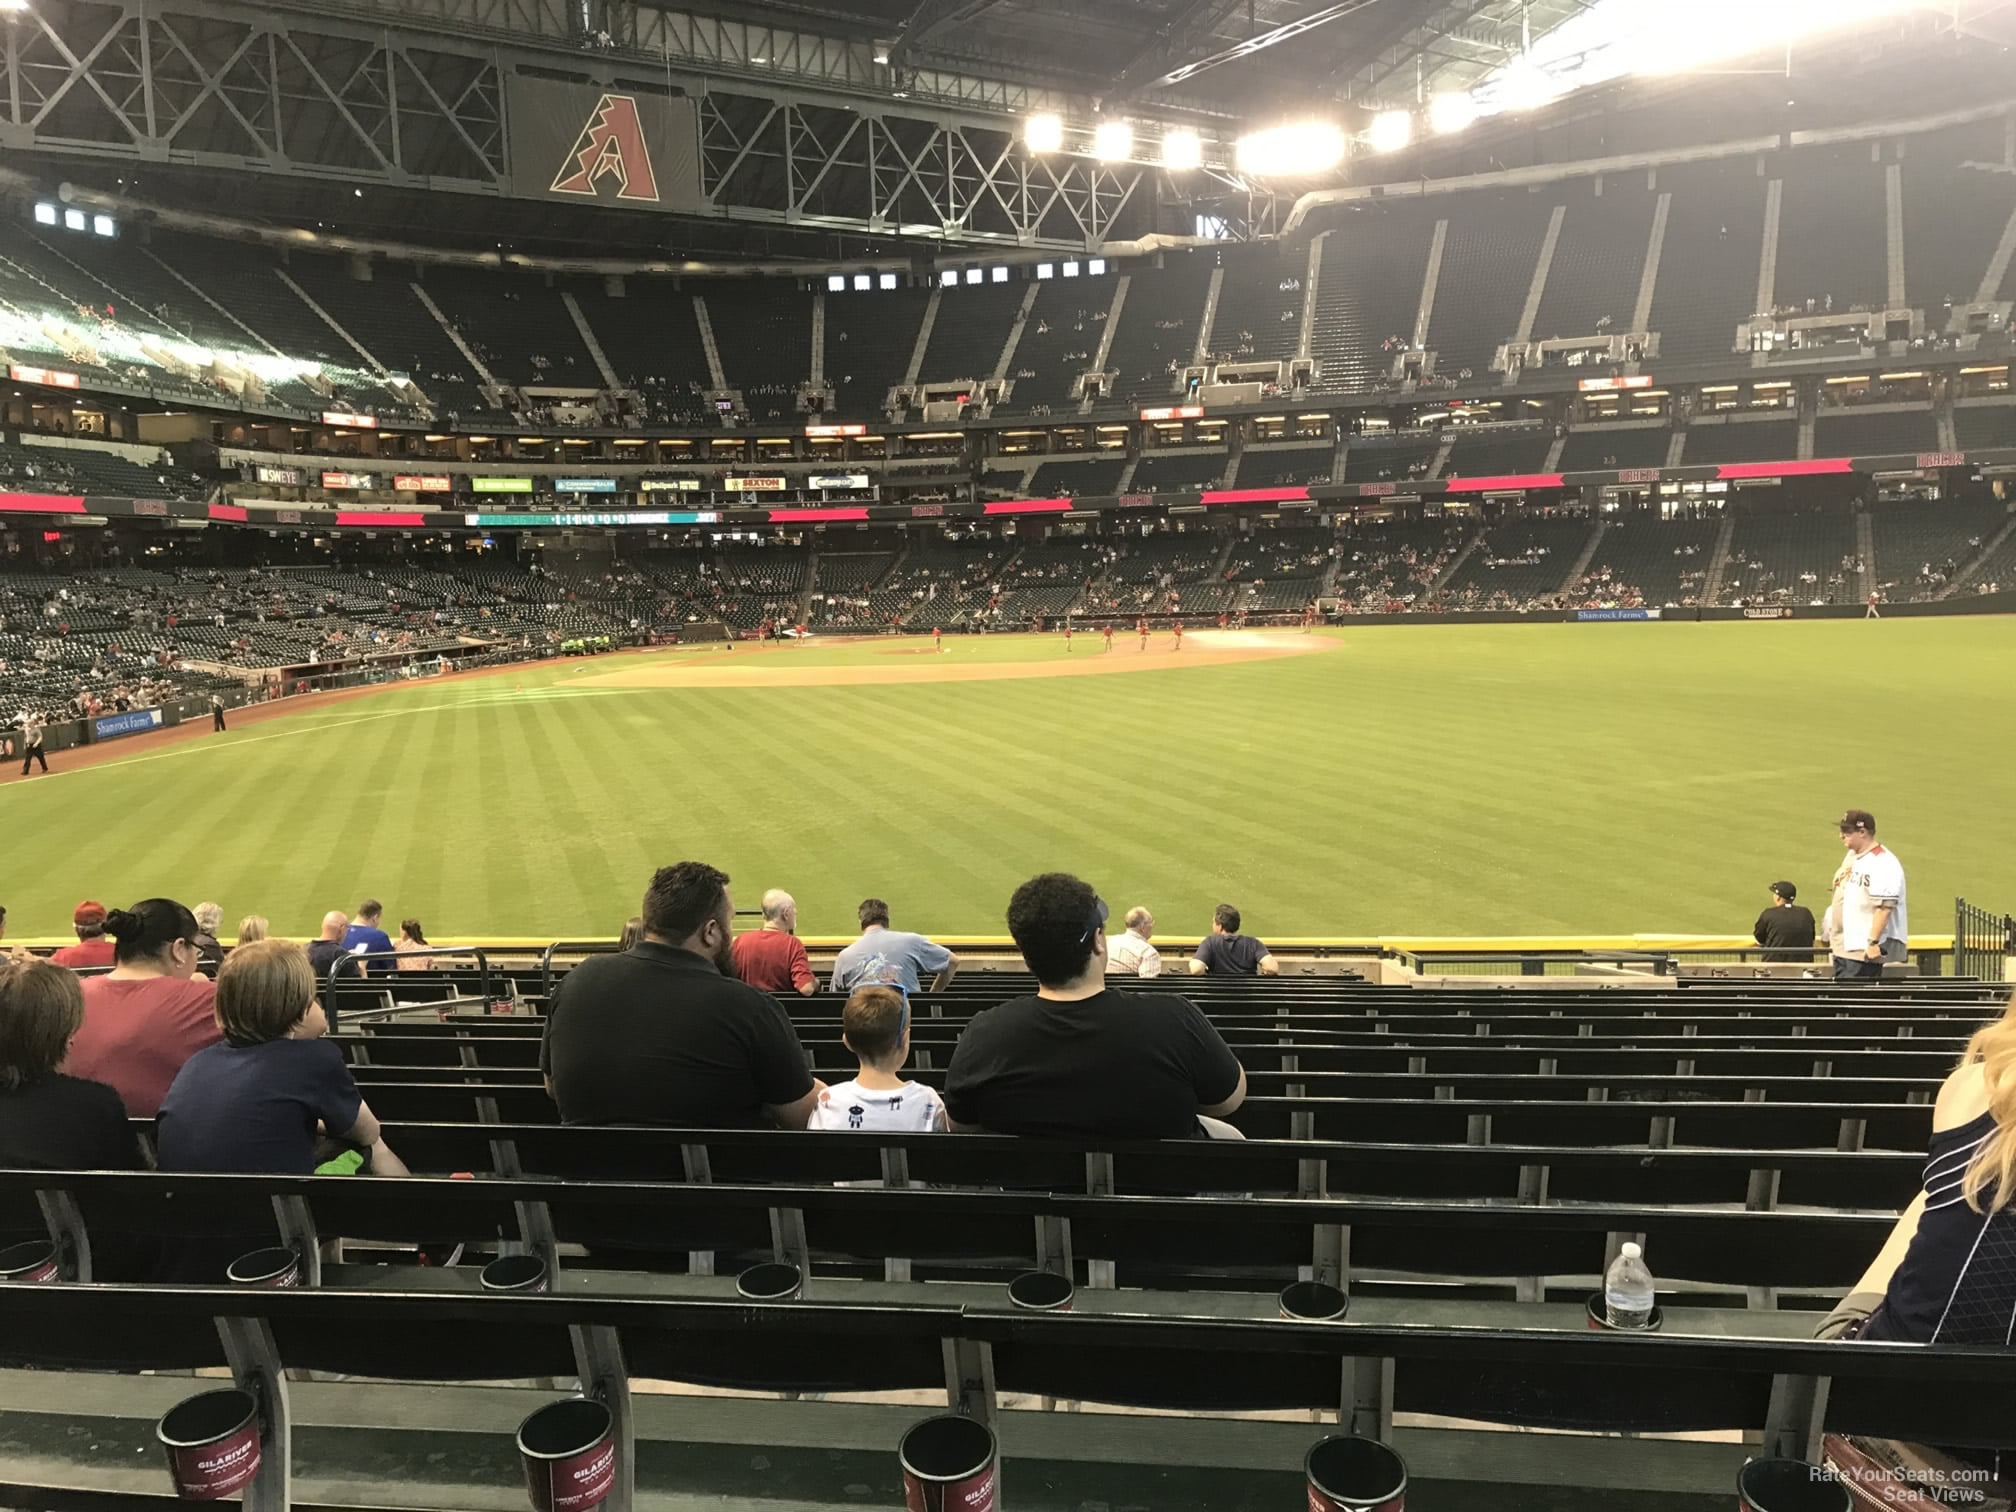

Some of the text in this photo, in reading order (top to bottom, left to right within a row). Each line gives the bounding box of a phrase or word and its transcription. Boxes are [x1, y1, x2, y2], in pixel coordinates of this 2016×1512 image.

[742, 479, 780, 487] SEXTON
[1578, 610, 1641, 619] Shamrock Farms
[96, 716, 149, 736] Shamrock Farms
